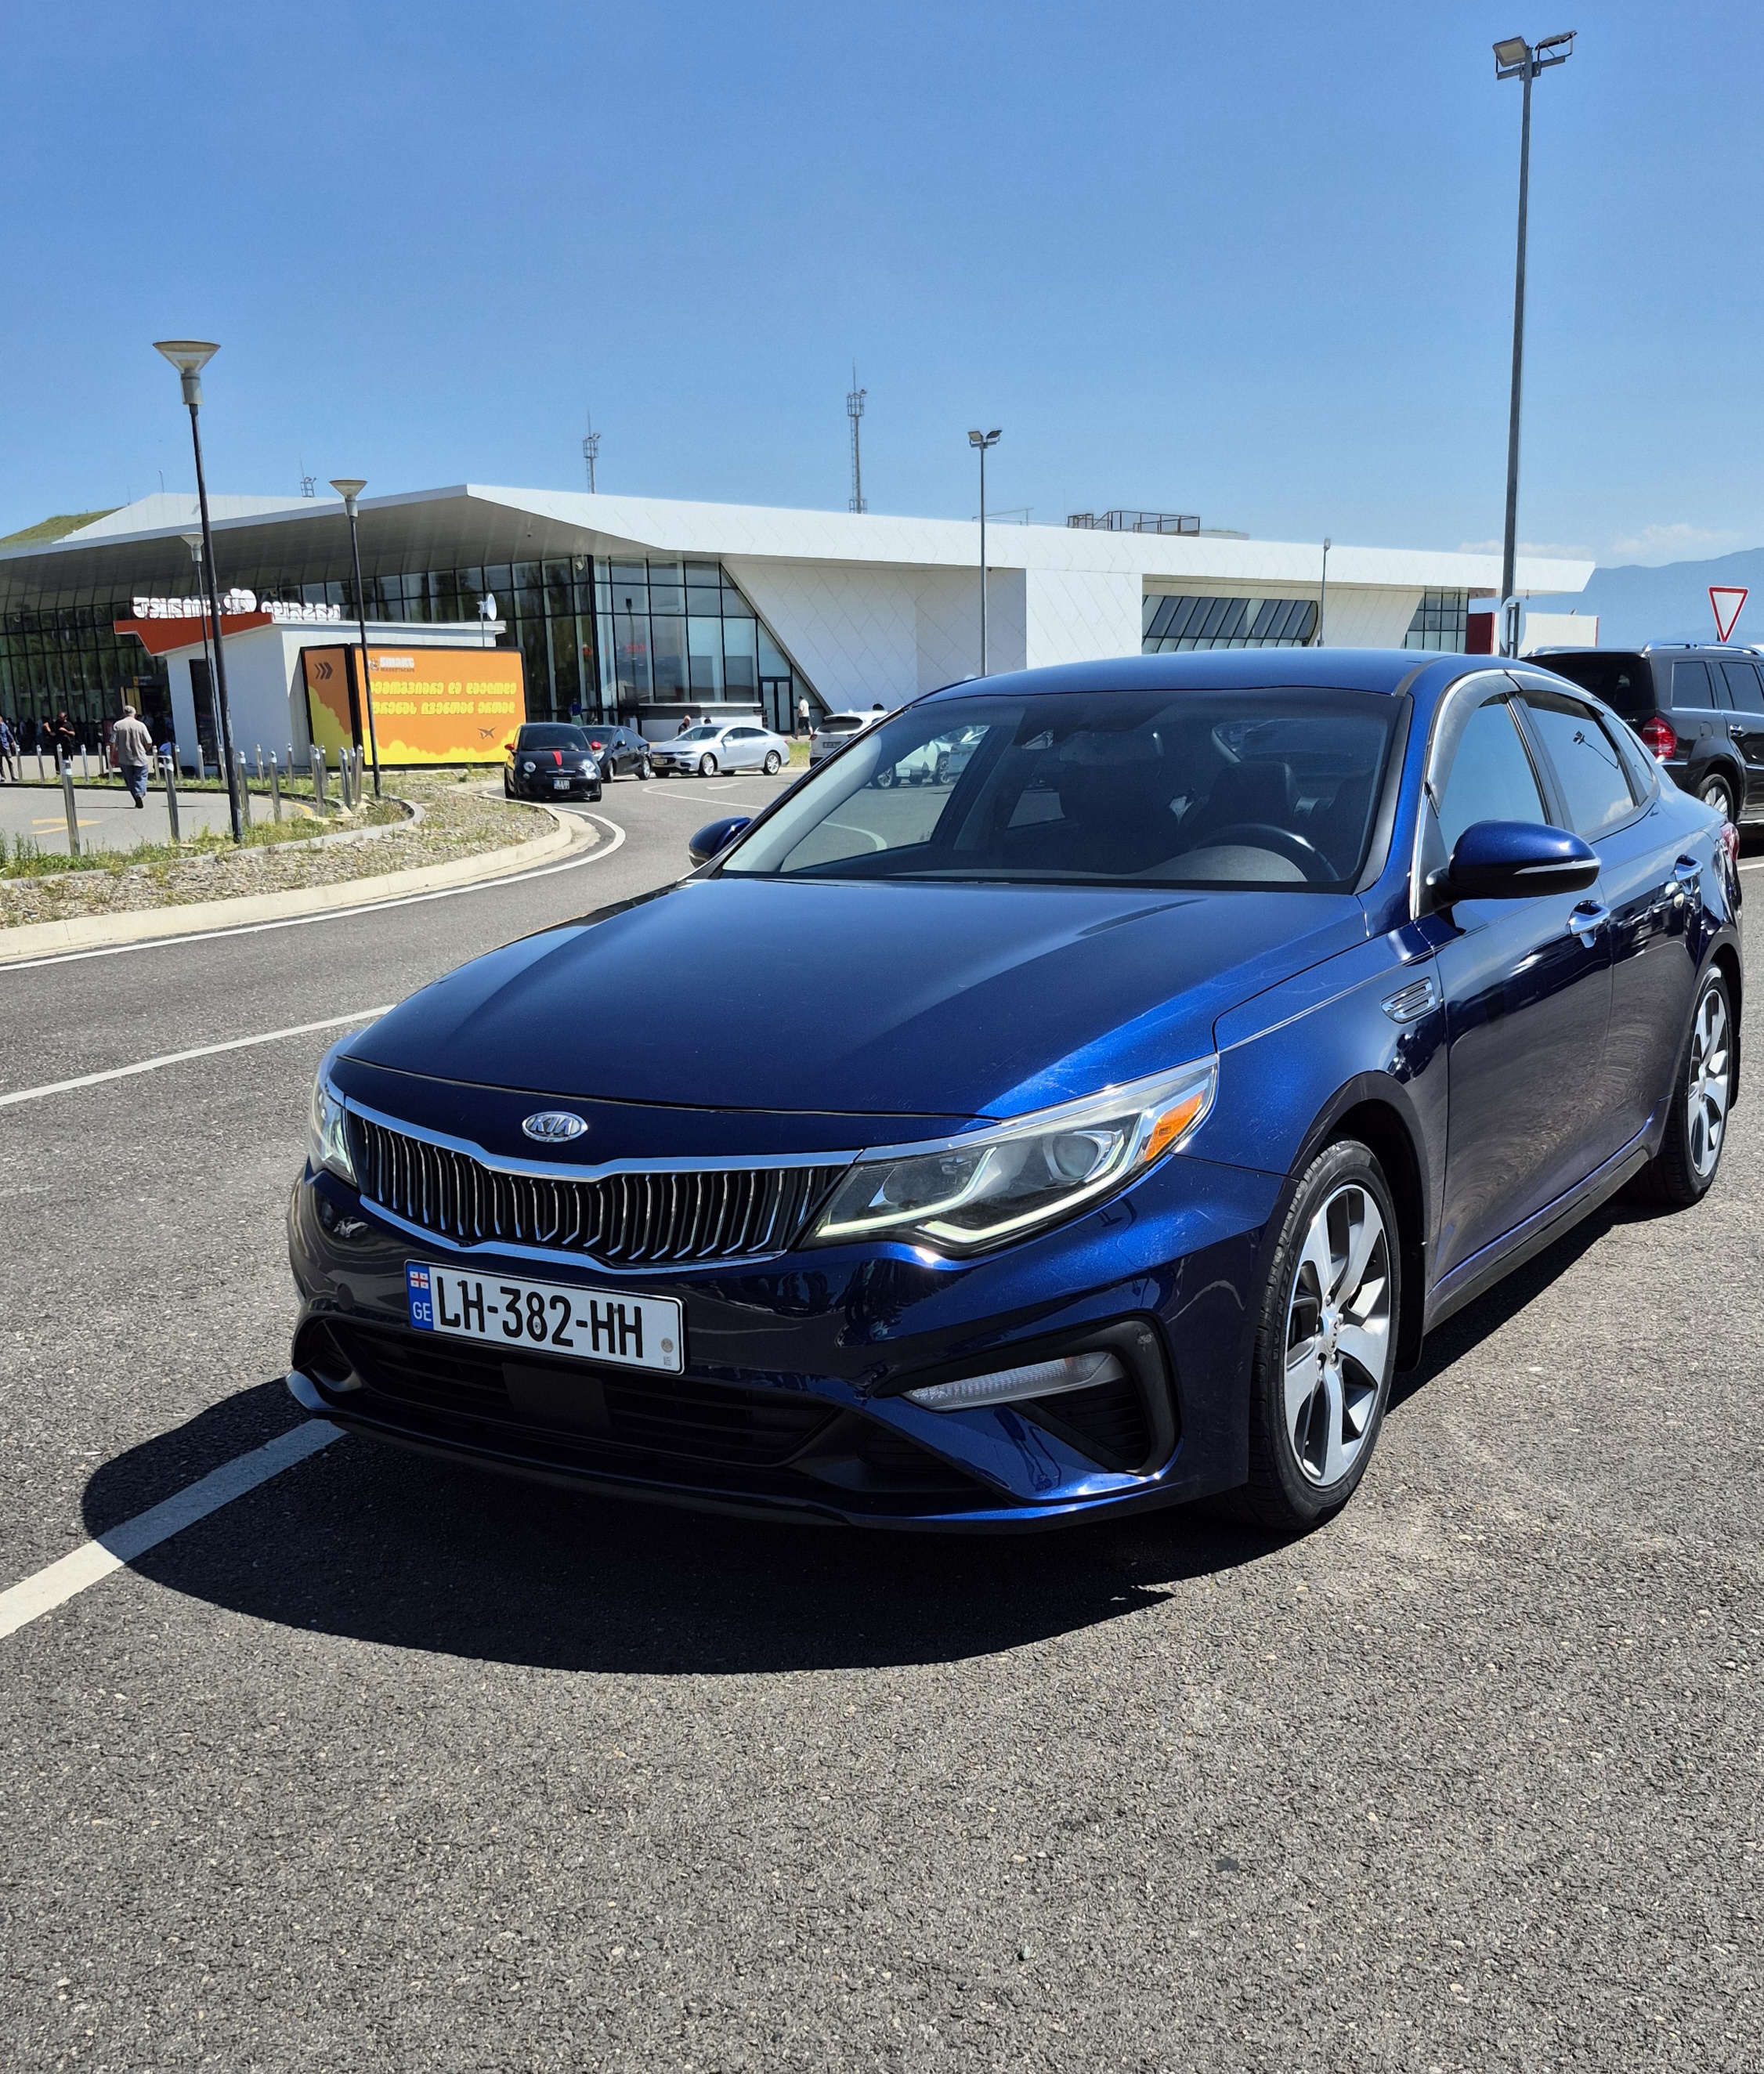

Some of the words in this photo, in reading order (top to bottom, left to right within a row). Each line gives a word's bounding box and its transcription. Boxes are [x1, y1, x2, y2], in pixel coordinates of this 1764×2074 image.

[447, 681, 462, 695] და
[530, 1115, 573, 1136] KIA
[412, 1300, 432, 1322] GE
[436, 1275, 643, 1358] LH-382-HH
